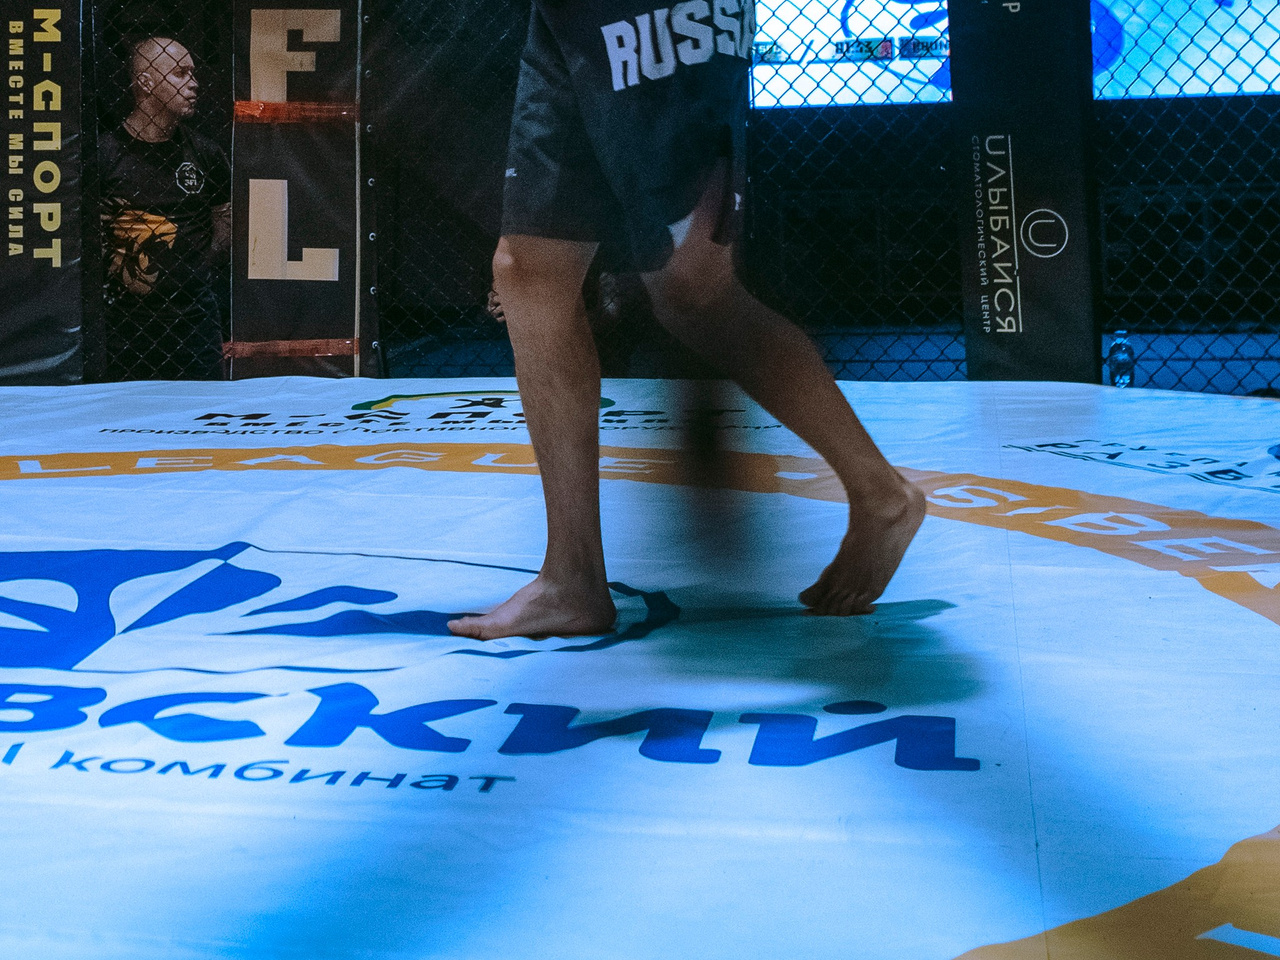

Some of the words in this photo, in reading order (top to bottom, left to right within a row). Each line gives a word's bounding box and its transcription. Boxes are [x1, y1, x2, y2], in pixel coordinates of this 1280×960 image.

[8, 21, 24, 120] ВМЕСТЕ
[8, 133, 24, 175] МЫ
[33, 8, 62, 268] М-СПОРТ
[8, 188, 24, 257] СИЛА
[971, 135, 990, 286] СТОМАТОЛОГИЧЕСКИЙ
[980, 294, 991, 333] ЦЕНТР
[51, 747, 517, 795] комбинат
